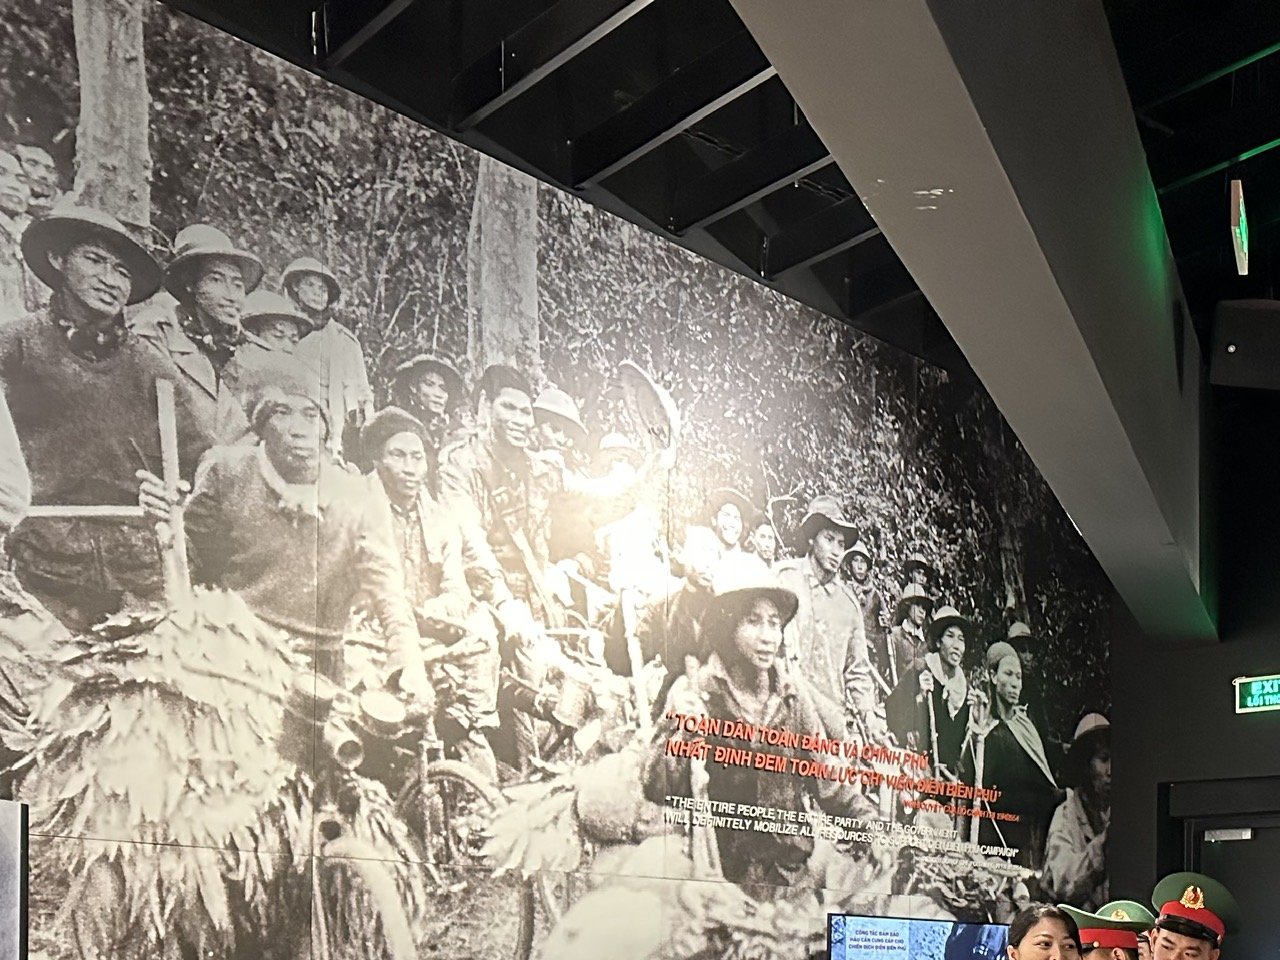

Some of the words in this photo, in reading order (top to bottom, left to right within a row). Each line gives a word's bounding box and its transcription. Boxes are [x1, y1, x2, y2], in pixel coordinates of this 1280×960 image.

[722, 719, 756, 741] DÂN
[759, 725, 800, 748] TOÀN
[802, 732, 840, 755] ĐẢNG
[844, 740, 859, 759] VÀ
[861, 745, 901, 766] CHÍNH
[903, 750, 929, 771] PHỦ
[665, 737, 712, 760] NHẤT
[714, 746, 752, 769] ĐỊNH
[754, 752, 788, 773] ĐEM
[790, 758, 828, 780] TOÀN
[917, 778, 946, 798] ĐIỆN
[946, 782, 974, 800] BIÊN
[665, 810, 690, 825] WILL
[692, 814, 752, 830] DEFINITELY
[754, 820, 799, 835] MOBILIZE
[800, 826, 817, 838] ALL
[818, 828, 873, 843] RESOURCES
[696, 799, 736, 814] ENTIRE
[737, 804, 776, 820] PEOPLE,
[777, 809, 797, 822] THE
[834, 816, 863, 829] PARTY
[866, 820, 884, 832] AND
[886, 823, 903, 834] THE
